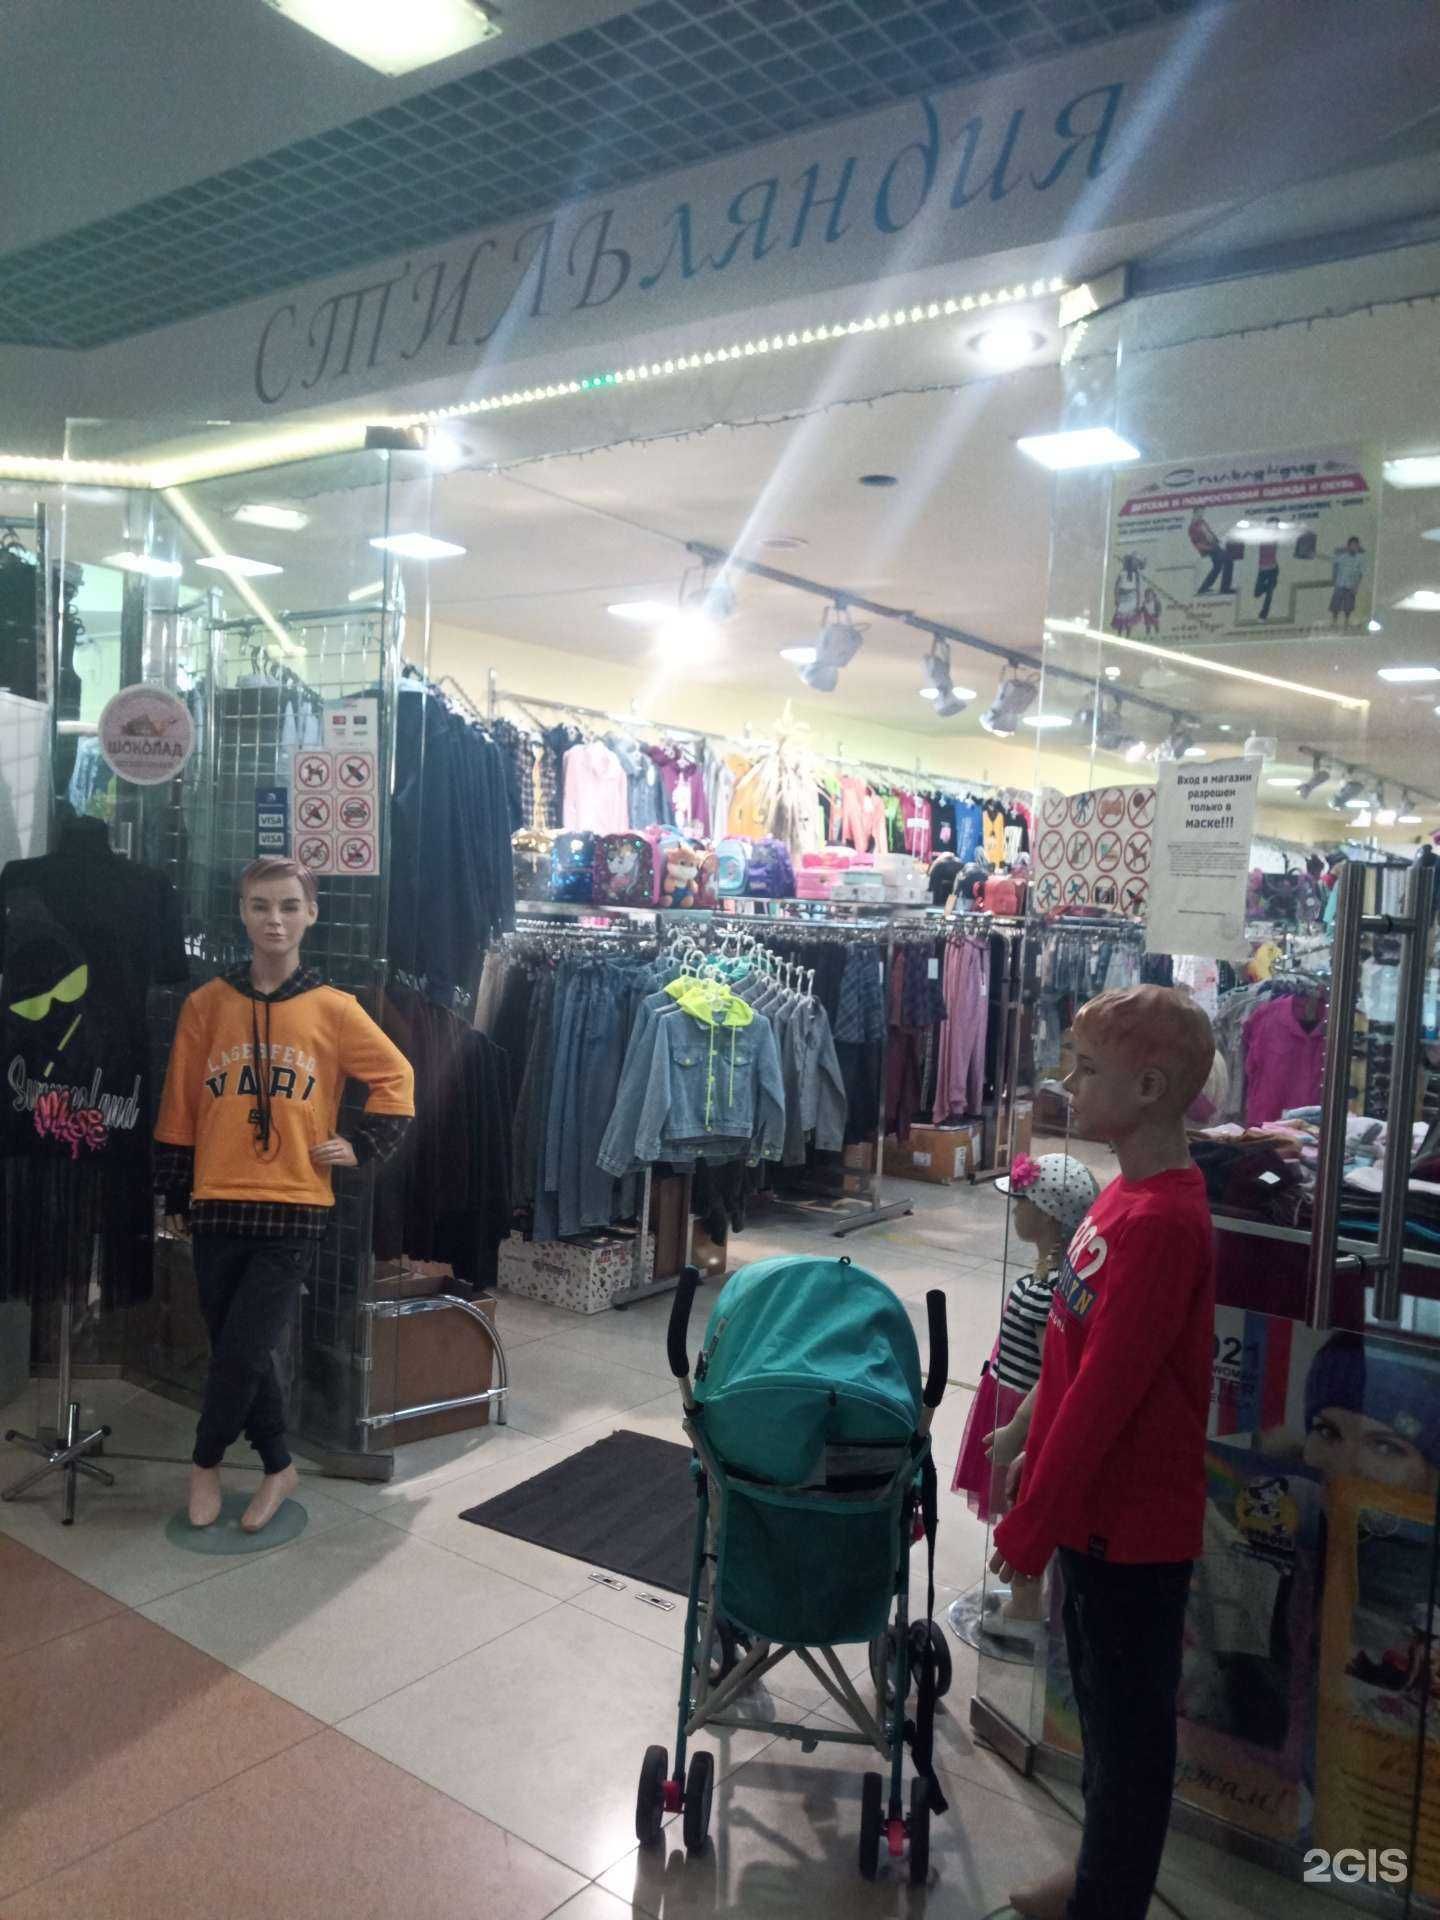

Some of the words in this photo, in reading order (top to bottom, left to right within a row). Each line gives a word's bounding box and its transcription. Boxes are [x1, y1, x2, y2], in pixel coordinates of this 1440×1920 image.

[1177, 775, 1200, 785] Вход
[1211, 774, 1252, 784] магазин
[1187, 788, 1236, 800] разрешен
[1190, 803, 1223, 812] только
[261, 816, 282, 825] VISA
[1185, 816, 1234, 829] маске!!!
[261, 834, 282, 844] VISA
